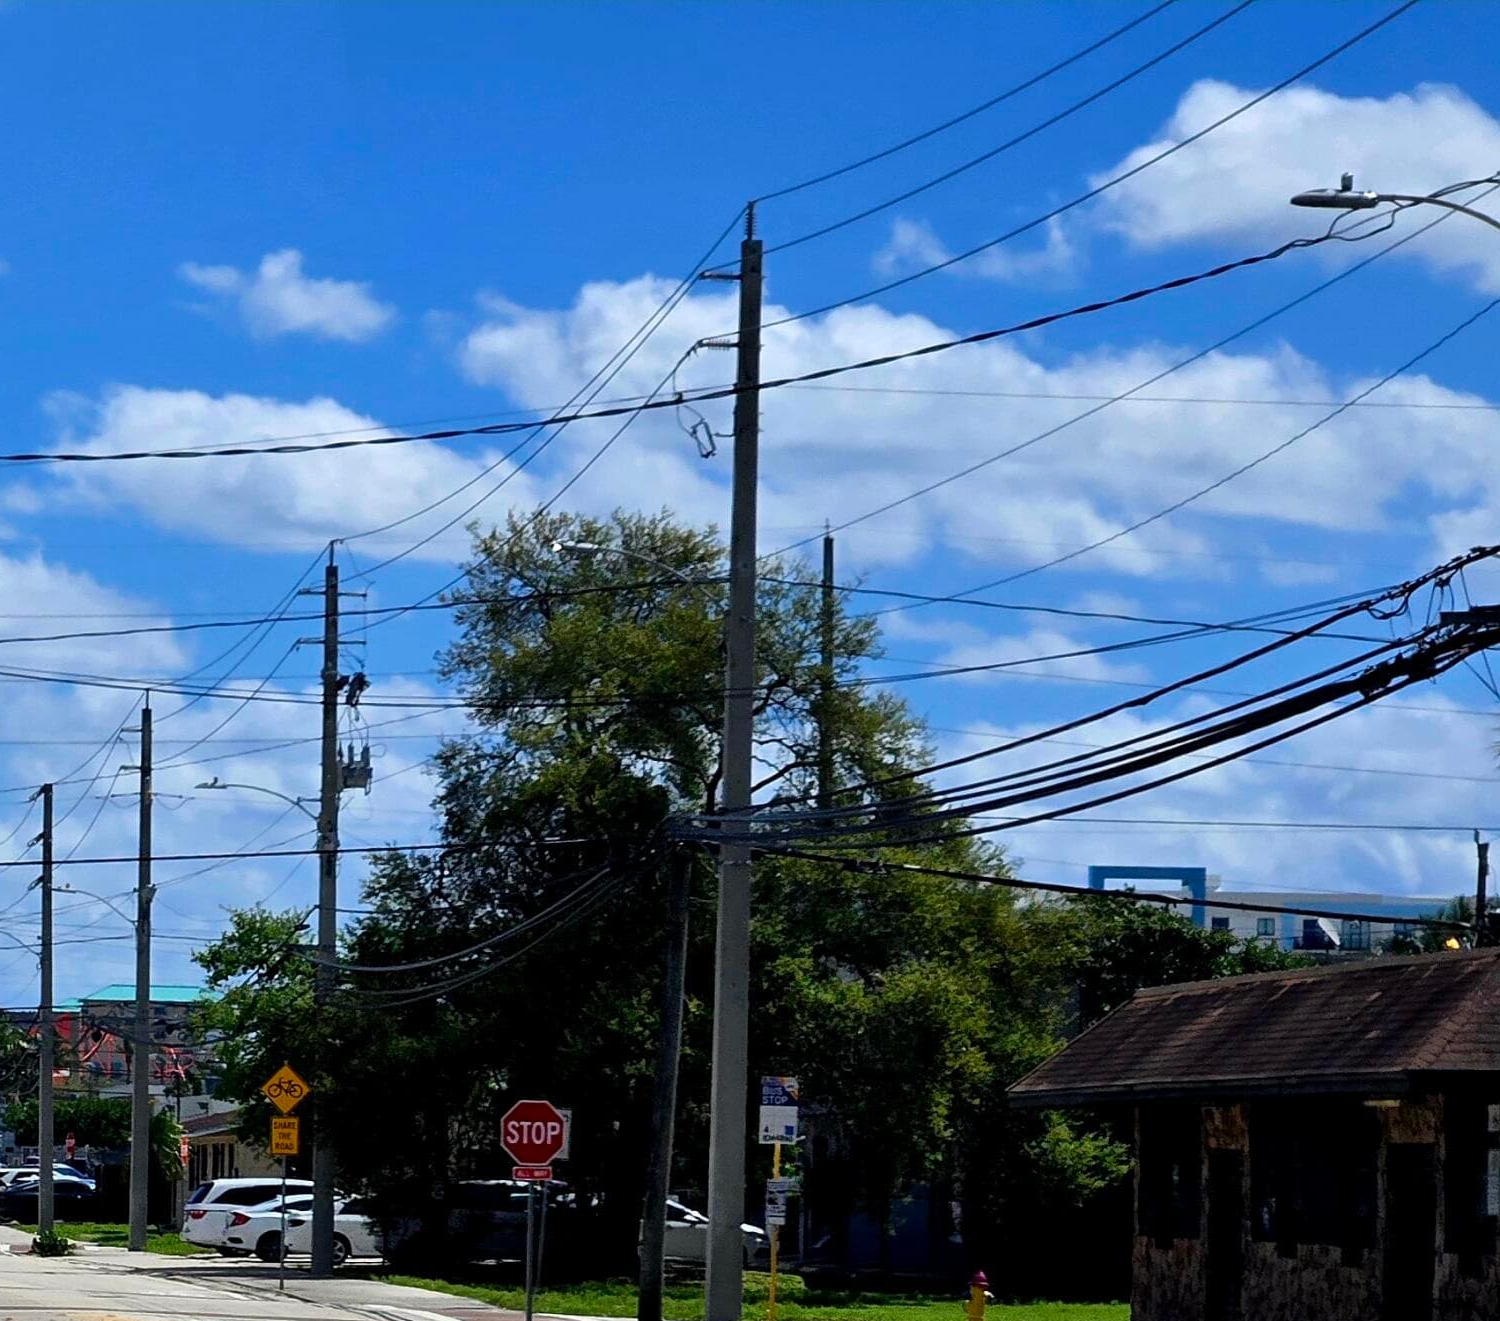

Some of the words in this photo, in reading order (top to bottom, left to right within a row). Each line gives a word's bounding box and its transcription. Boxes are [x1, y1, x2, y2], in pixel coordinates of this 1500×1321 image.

[762, 1086, 783, 1096] BUS
[762, 1095, 789, 1105] STOP
[273, 1120, 297, 1130] SHARE
[506, 1120, 561, 1145] STOP
[275, 1142, 294, 1150] ROAD
